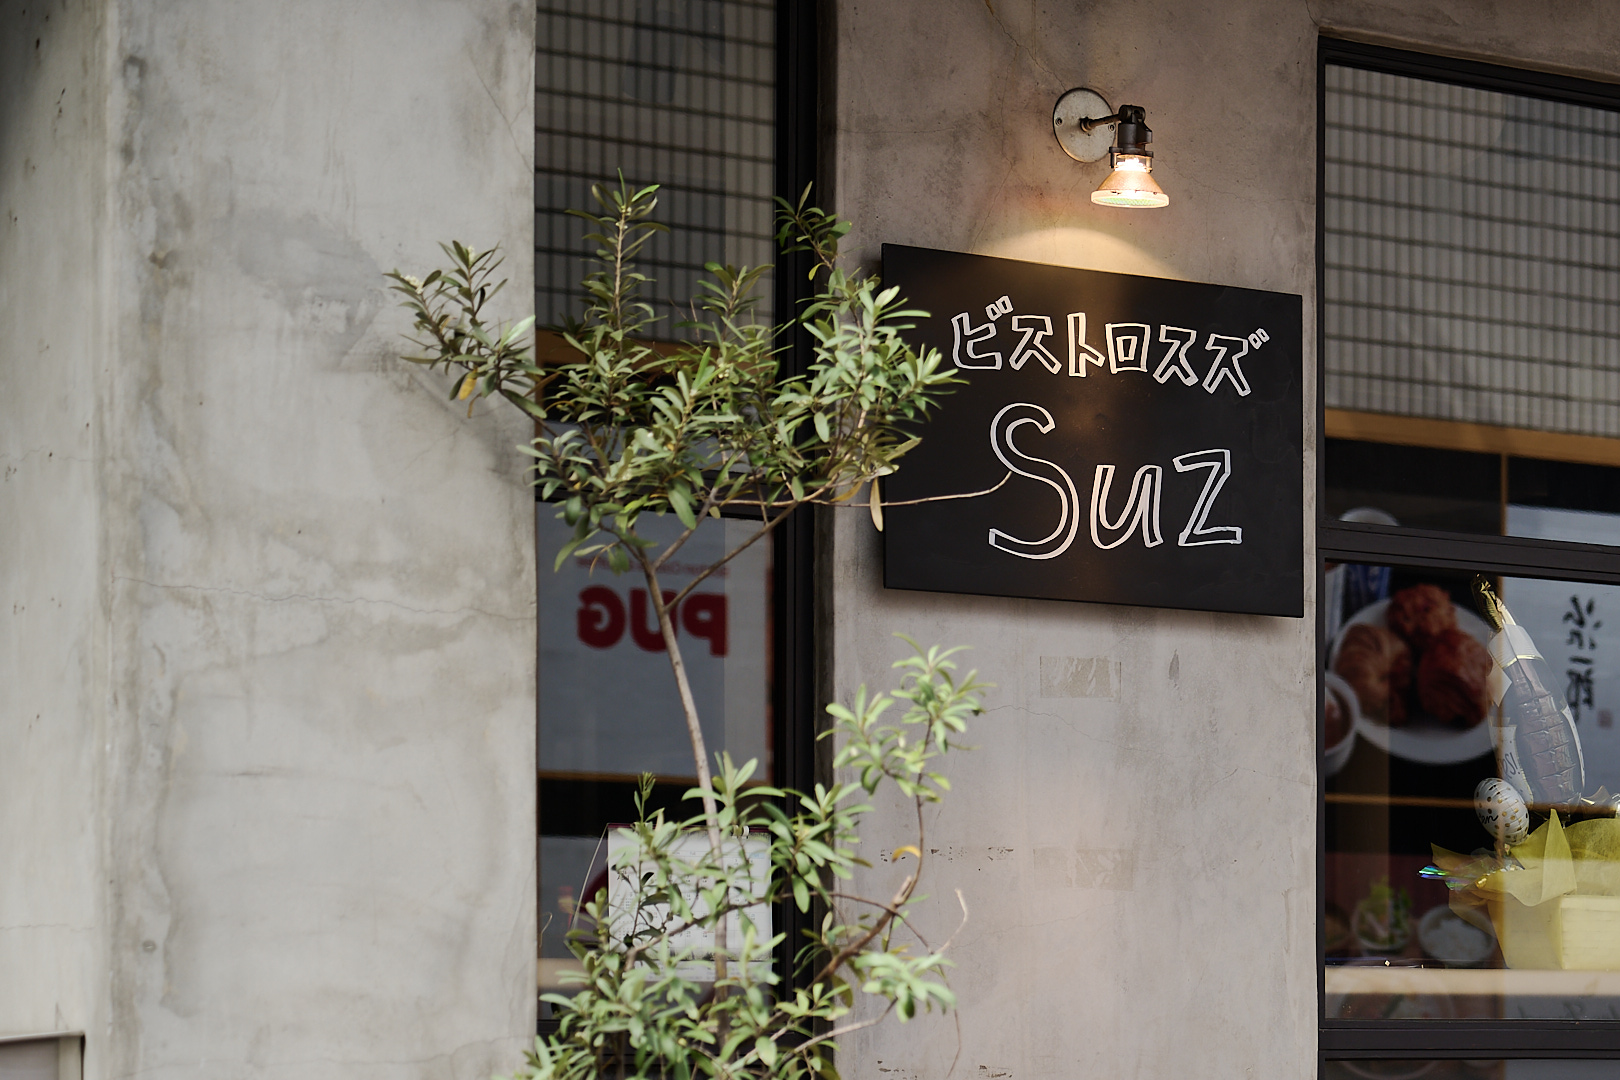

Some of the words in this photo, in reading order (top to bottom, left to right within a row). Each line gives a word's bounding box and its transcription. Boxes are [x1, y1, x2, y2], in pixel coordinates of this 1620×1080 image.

[952, 296, 1270, 396] ビストロスズ
